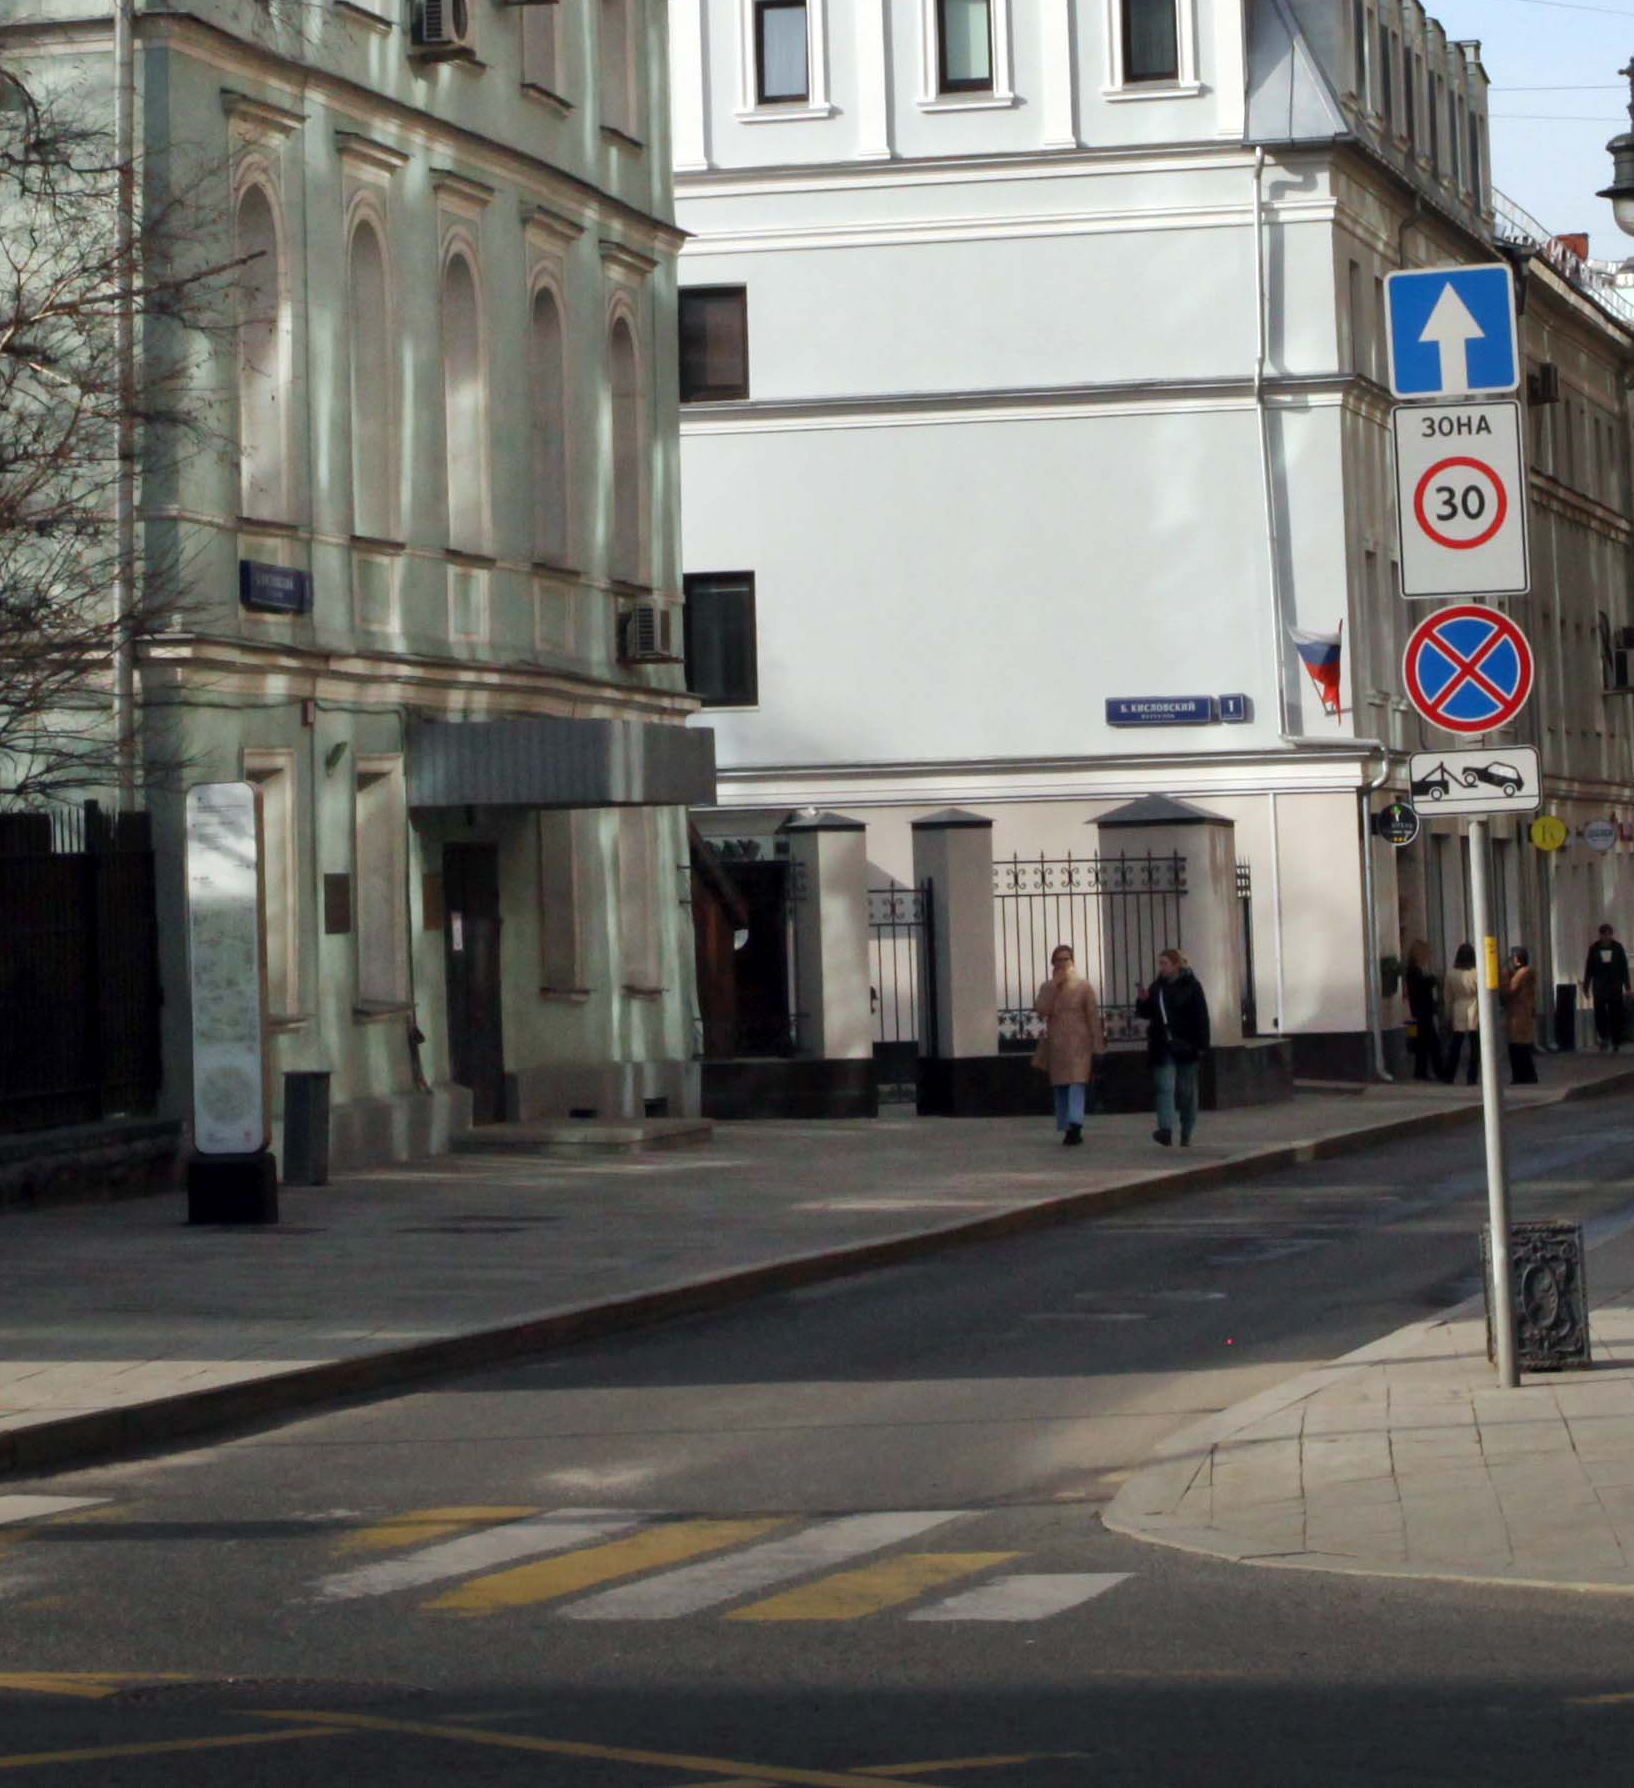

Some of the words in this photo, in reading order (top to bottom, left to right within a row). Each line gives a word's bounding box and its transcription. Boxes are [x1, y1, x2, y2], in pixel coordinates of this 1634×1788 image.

[1421, 414, 1492, 437] ЗОНА
[1435, 484, 1486, 522] 30
[1130, 701, 1196, 713] КИСЛОВСКИЙ
[1228, 699, 1234, 712] 1
